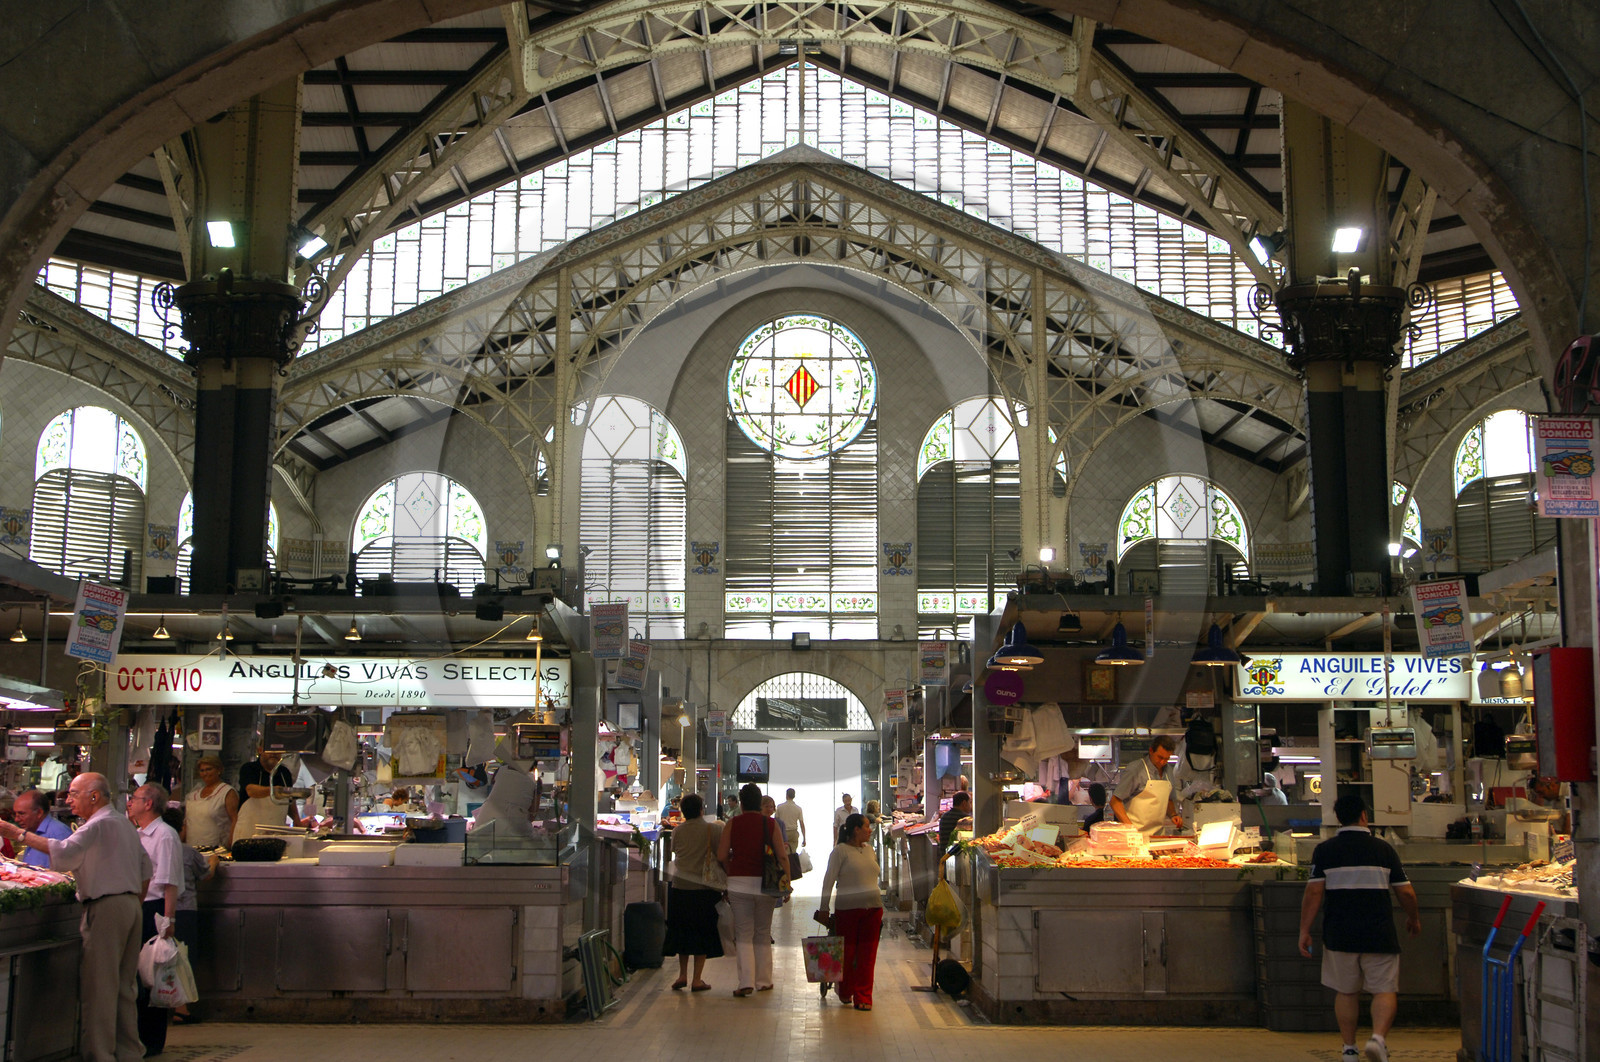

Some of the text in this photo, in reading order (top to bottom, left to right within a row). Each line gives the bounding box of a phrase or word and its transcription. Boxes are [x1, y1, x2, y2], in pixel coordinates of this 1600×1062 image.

[1540, 430, 1592, 438] DOMICILIO
[85, 584, 116, 597] SERVICIO
[1417, 584, 1450, 593] SERVICIO
[1418, 590, 1459, 600] DOMICILIO
[84, 590, 122, 605] DOMICILIO
[229, 662, 560, 681] ANGUILS VIVAS SELECTAS
[1300, 658, 1461, 673] ANGUILES VIVES
[118, 667, 202, 691] OCTAVIO
[365, 690, 426, 698] Desde 1890
